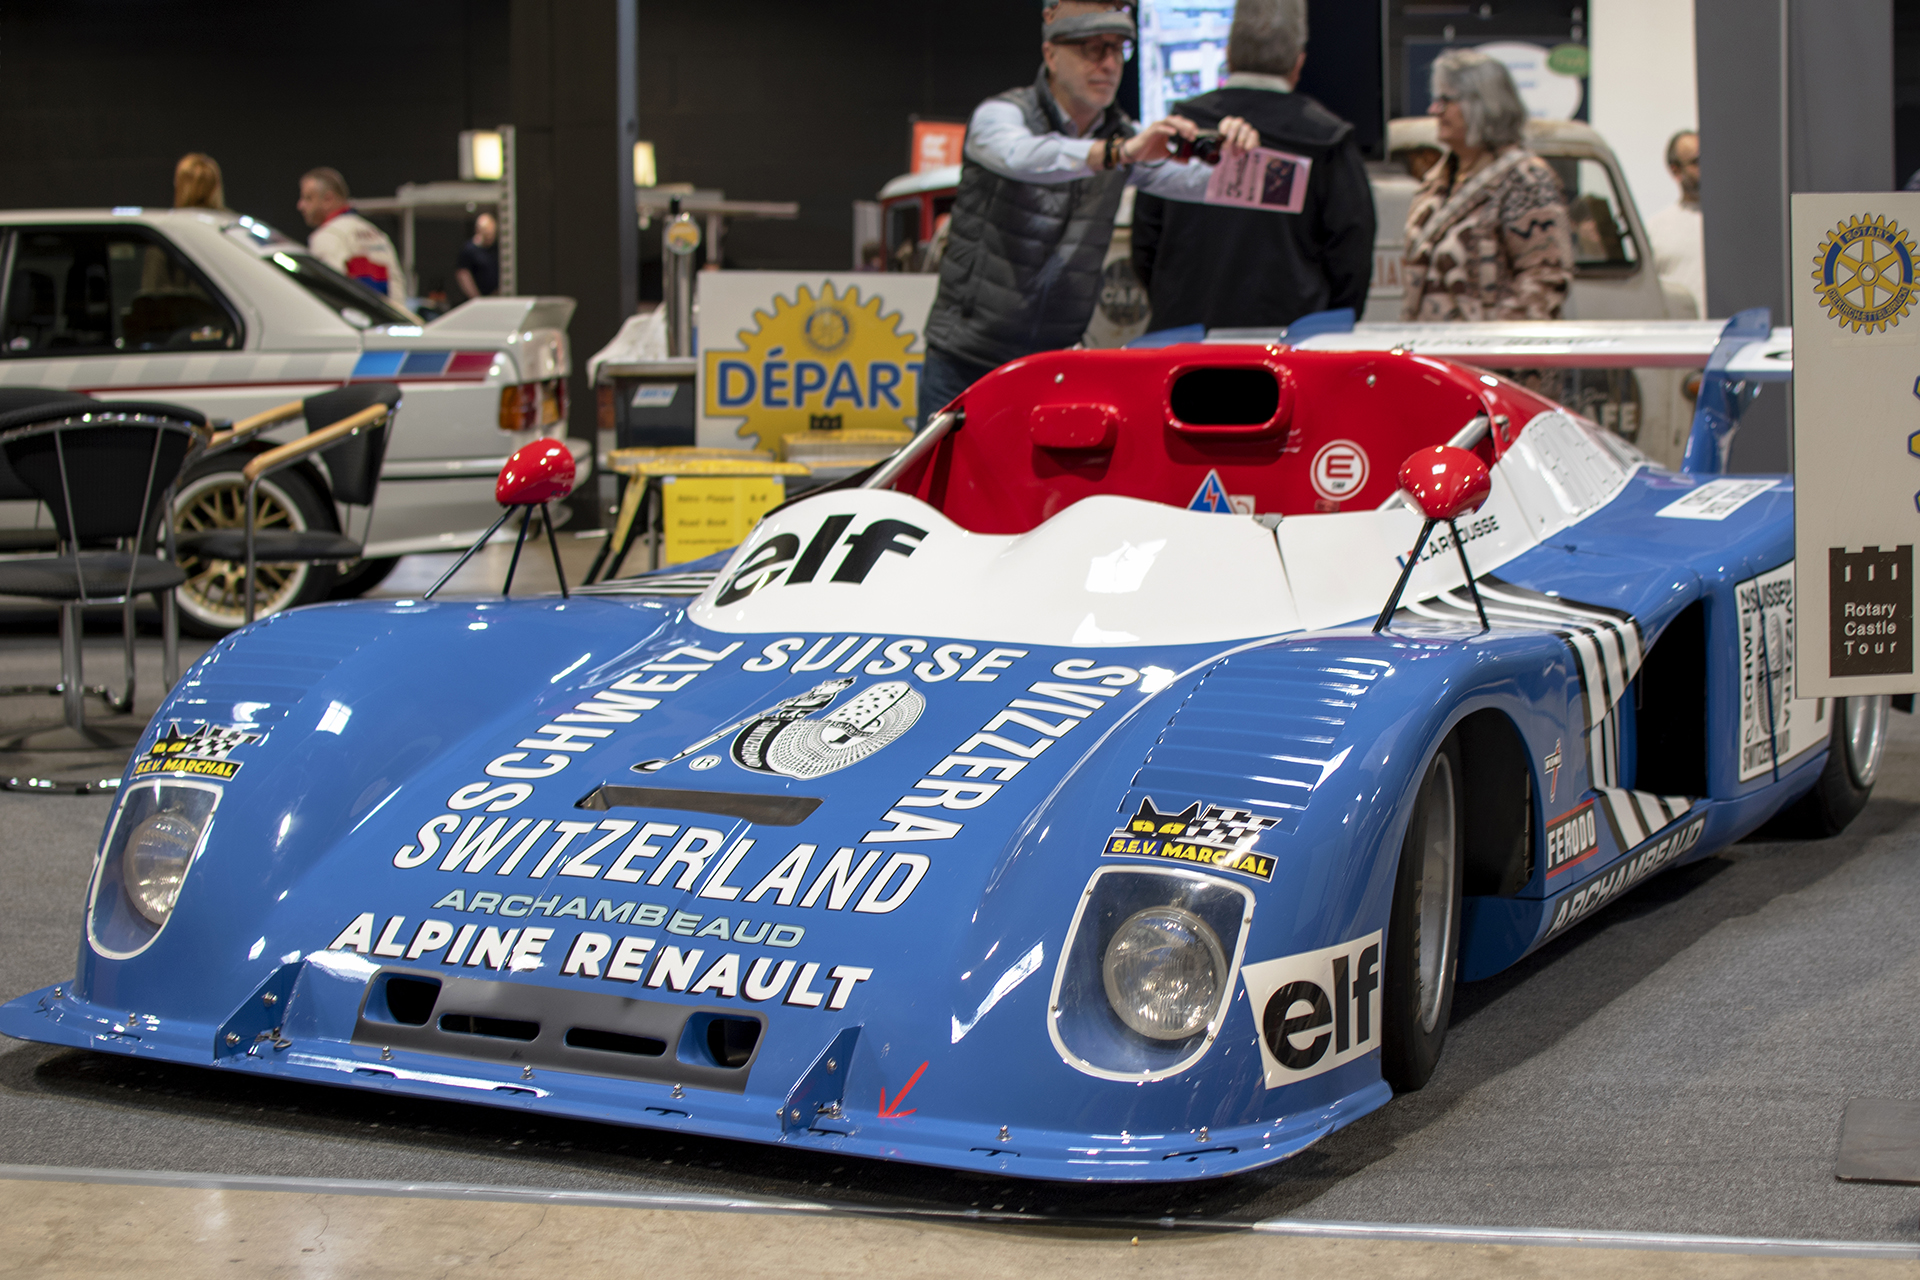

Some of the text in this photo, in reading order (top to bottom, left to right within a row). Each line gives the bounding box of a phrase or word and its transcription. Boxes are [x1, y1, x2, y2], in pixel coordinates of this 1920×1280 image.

[1845, 226, 1891, 242] ROTARY
[715, 513, 930, 607] elf
[1844, 602, 1897, 619] Rotary
[1844, 620, 1897, 637] Castle
[741, 636, 1029, 683] SUISSE
[1844, 640, 1897, 655] Tour
[446, 640, 745, 812] SCHWEIZ
[861, 658, 1142, 844] SVIZZERA
[135, 758, 234, 777] S.E.V. MARCHAL
[394, 813, 931, 914] SWITZERLAND
[1111, 838, 1157, 856] S.E.V.
[1546, 808, 1597, 869] FERODO
[1544, 818, 1706, 938] ARCHAMBEAUD
[432, 888, 806, 947] ARCHAMBEAUD
[328, 911, 874, 1011] ALPINE RENAULT
[1262, 943, 1379, 1070] elf
